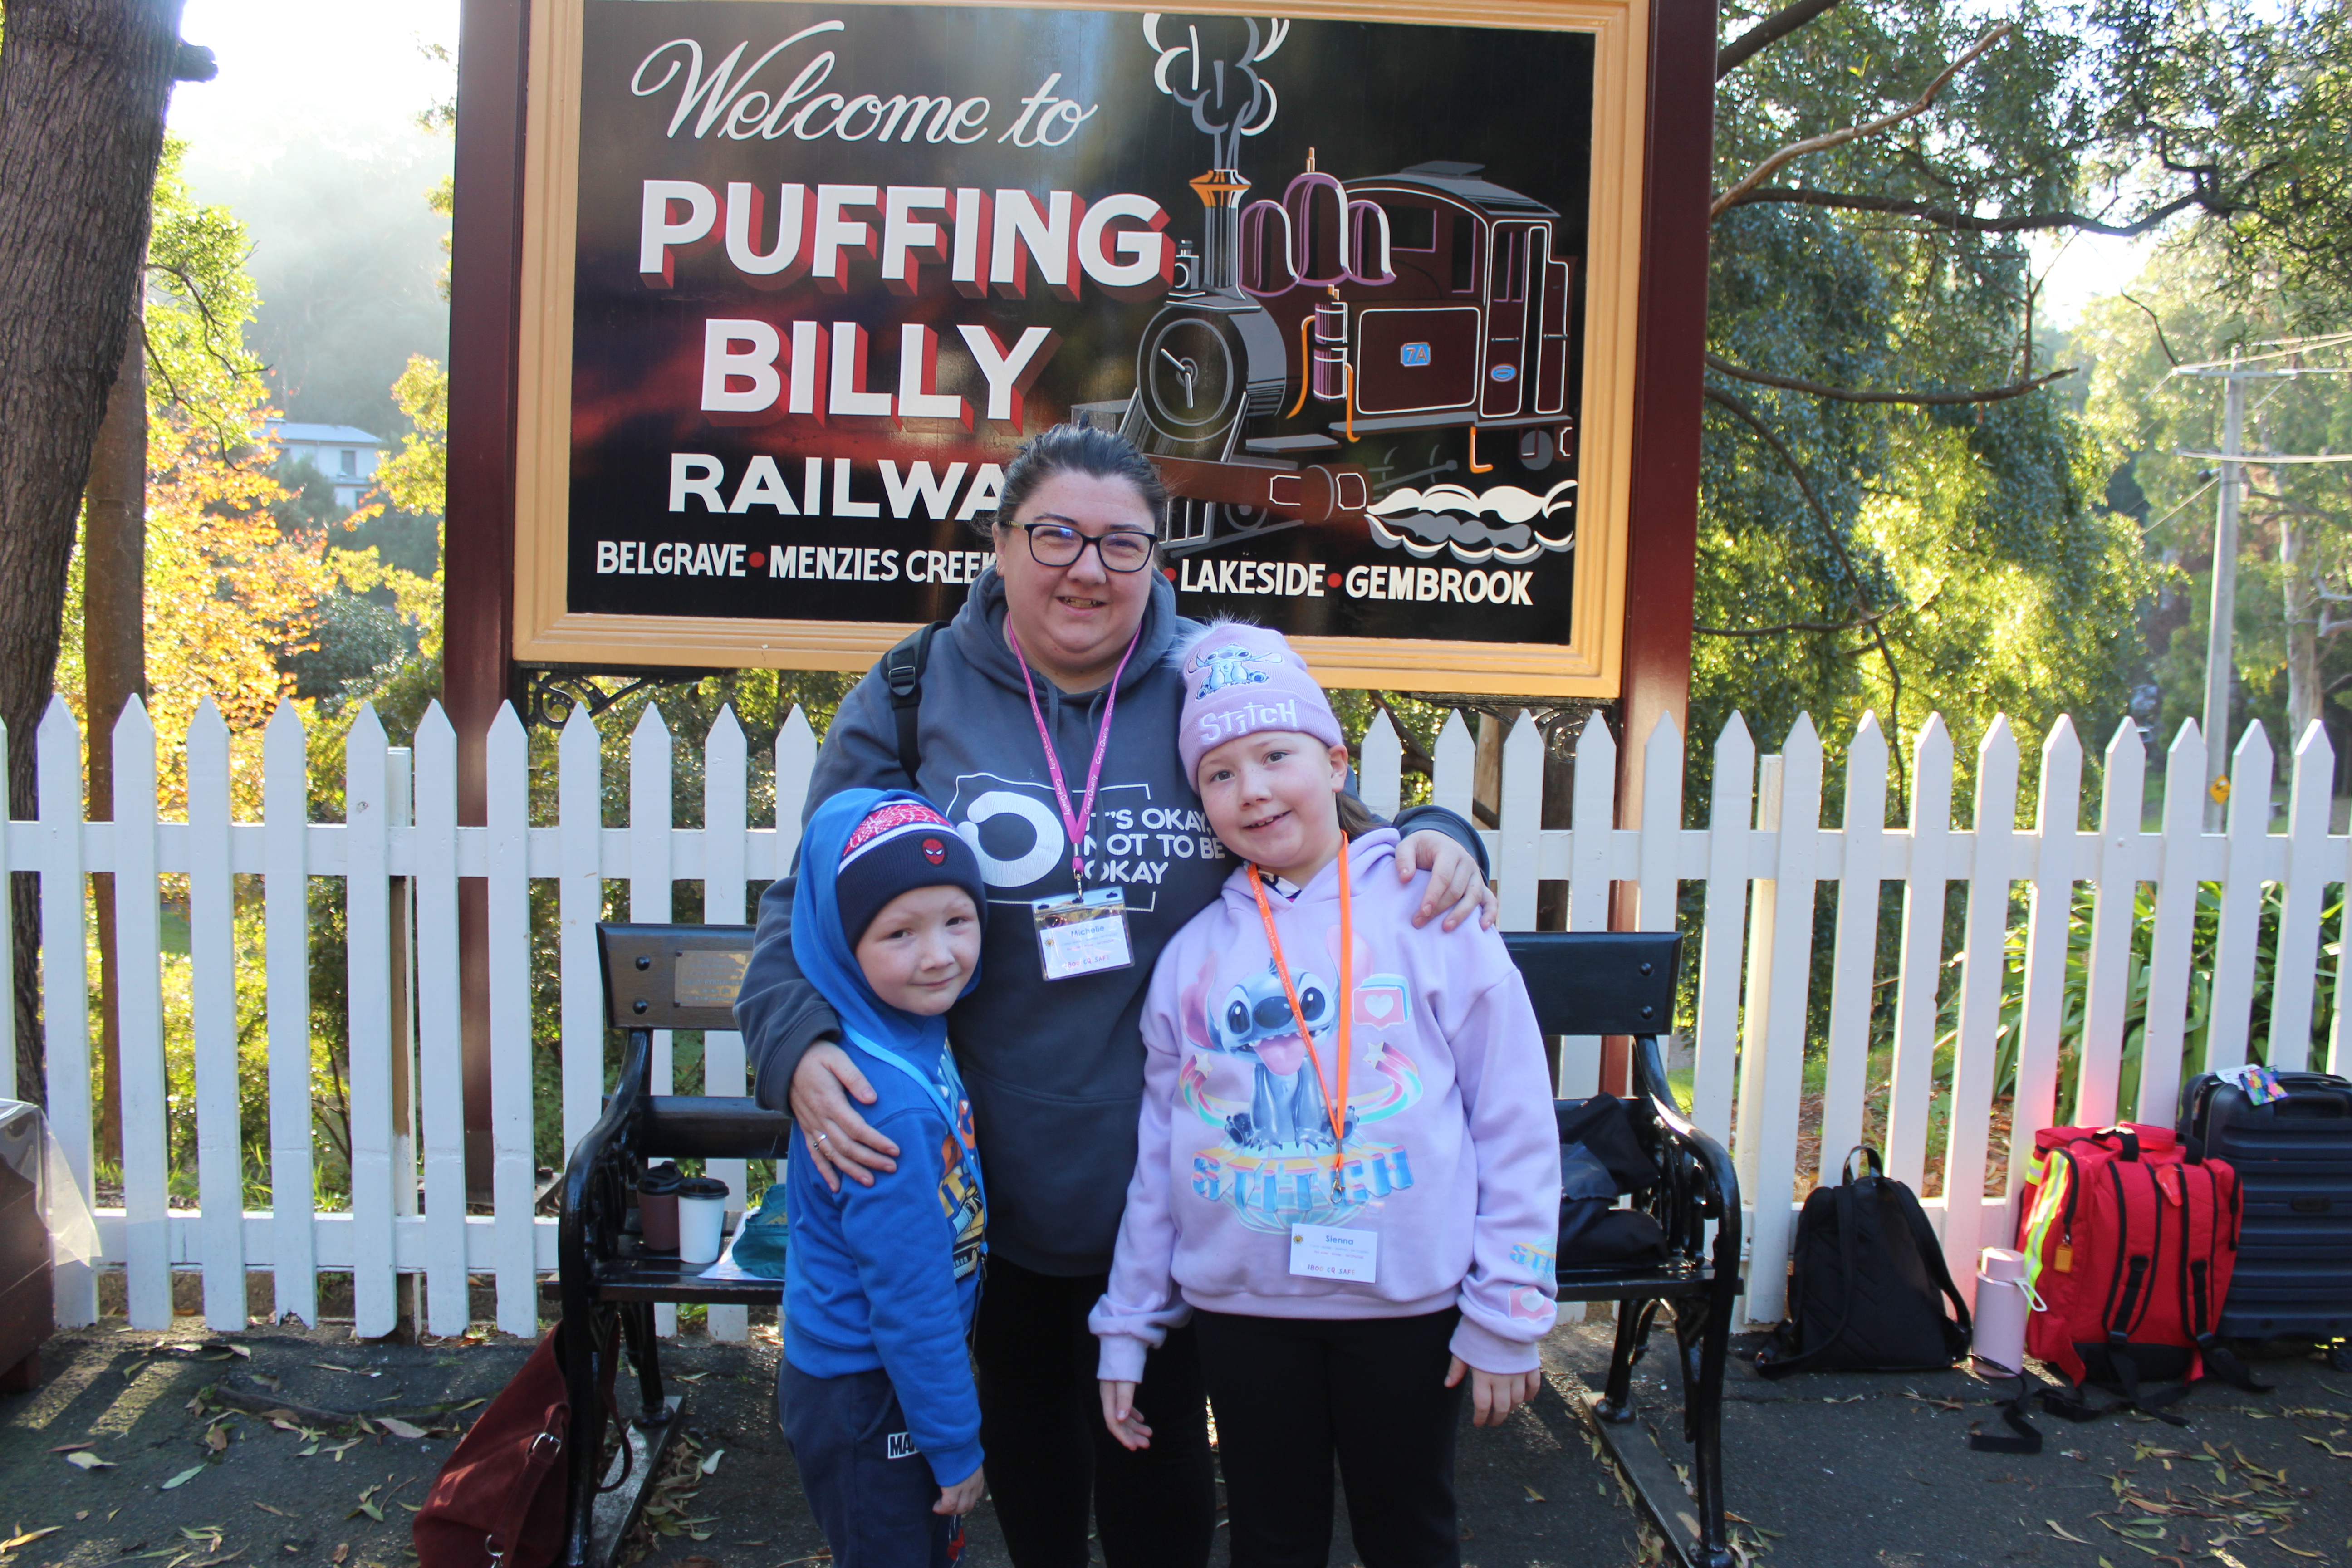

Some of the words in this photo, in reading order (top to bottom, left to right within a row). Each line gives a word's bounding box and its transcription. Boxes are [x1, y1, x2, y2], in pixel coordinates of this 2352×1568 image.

[630, 20, 987, 144] Welcome
[998, 73, 1098, 148] to
[639, 180, 1175, 299] PUFFING
[1406, 346, 1427, 363] 7A
[699, 318, 1059, 431] BILLY
[669, 453, 1006, 521] RAILWA
[596, 541, 747, 577] BELGRAVE
[769, 545, 898, 582] MENZIES
[1180, 559, 1325, 597] LAKESIDE
[1345, 565, 1534, 606] GEMBROOK
[1095, 749, 1105, 765] Camp
[1100, 726, 1109, 747] Quality
[1047, 748, 1056, 770] Quality
[1088, 774, 1098, 796] Quality
[1060, 794, 1071, 816] Quality
[1084, 797, 1093, 815] Camp
[1156, 834, 1194, 858] TO
[1199, 837, 1225, 859] BE
[1084, 860, 1169, 884] OKAY
[1071, 926, 1104, 937] Michelle
[1264, 916, 1273, 937] Quality
[1095, 955, 1110, 963] SAFE
[1277, 960, 1286, 984] Quality
[1191, 1142, 1415, 1212] STITCH
[1325, 1235, 1354, 1245] Sienna
